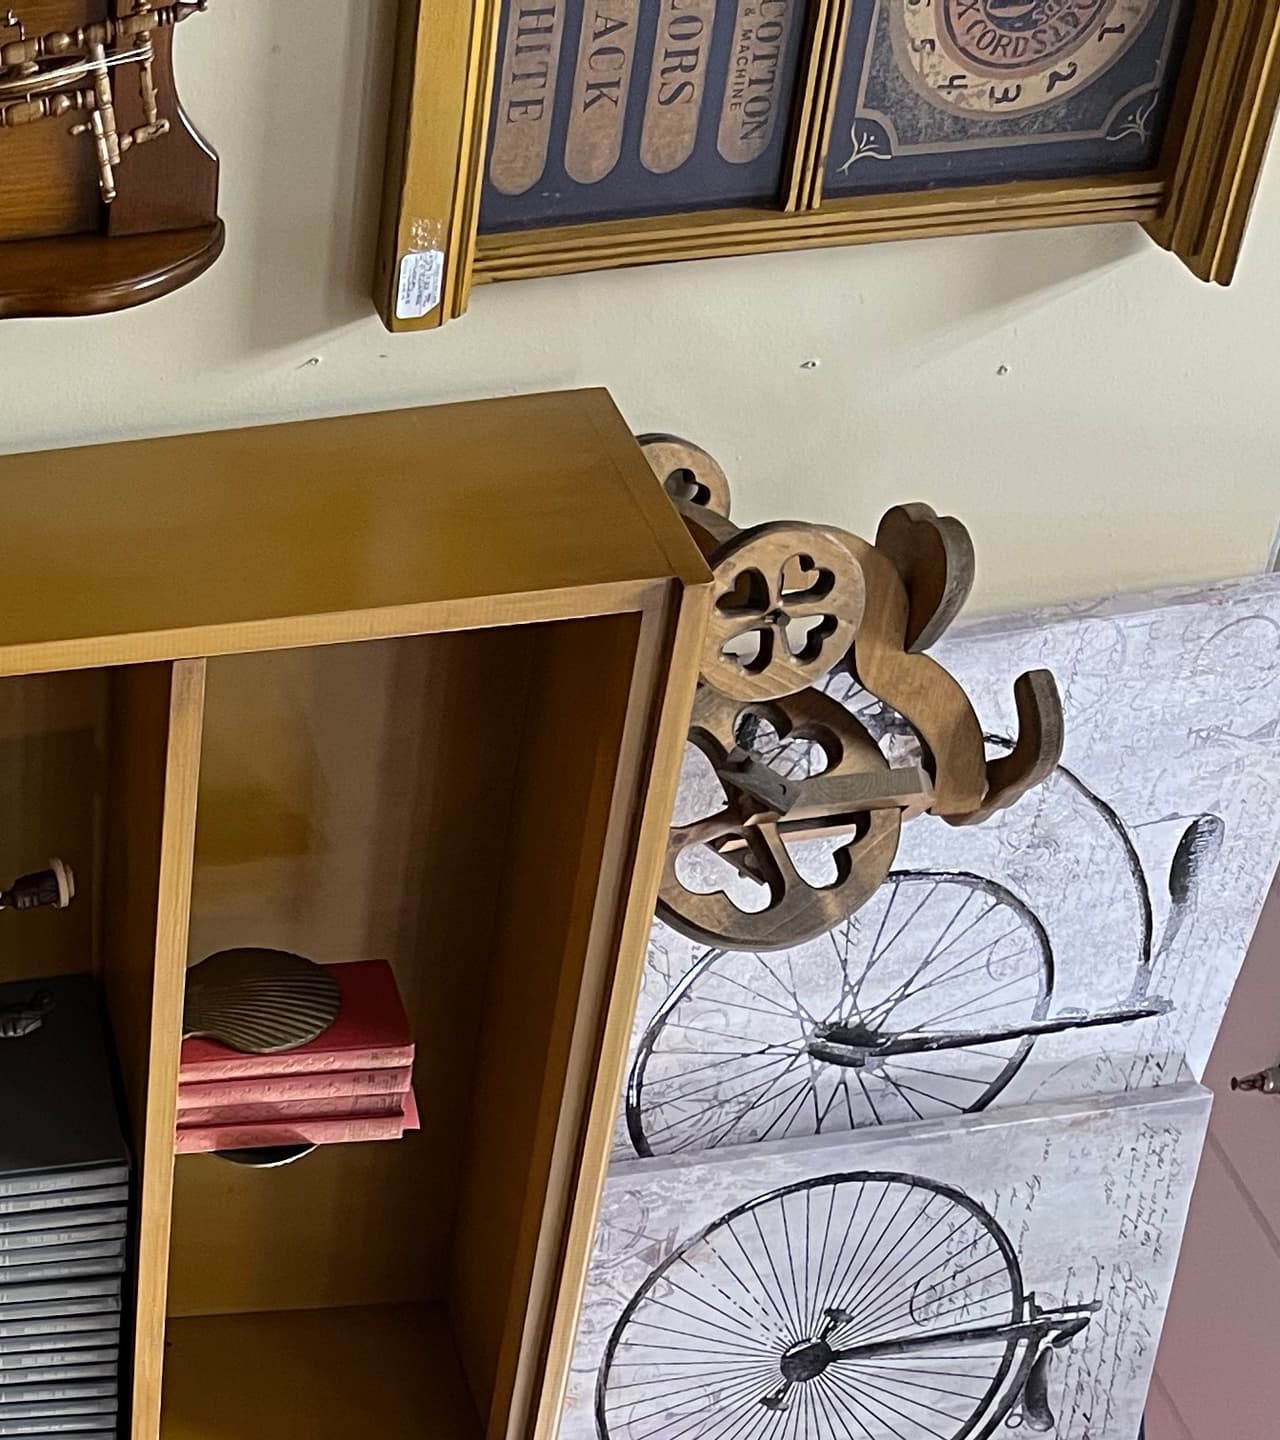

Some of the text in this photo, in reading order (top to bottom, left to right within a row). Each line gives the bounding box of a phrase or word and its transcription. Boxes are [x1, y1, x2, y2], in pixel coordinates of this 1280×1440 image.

[506, 5, 556, 124] HITE
[583, 11, 629, 113] ACK
[729, 8, 756, 113] & MACHINE
[965, 19, 1027, 59] CORD
[1097, 23, 1126, 42] 1
[739, 0, 789, 141] COTTON
[989, 84, 1021, 105] 3
[1046, 61, 1078, 93] 2
